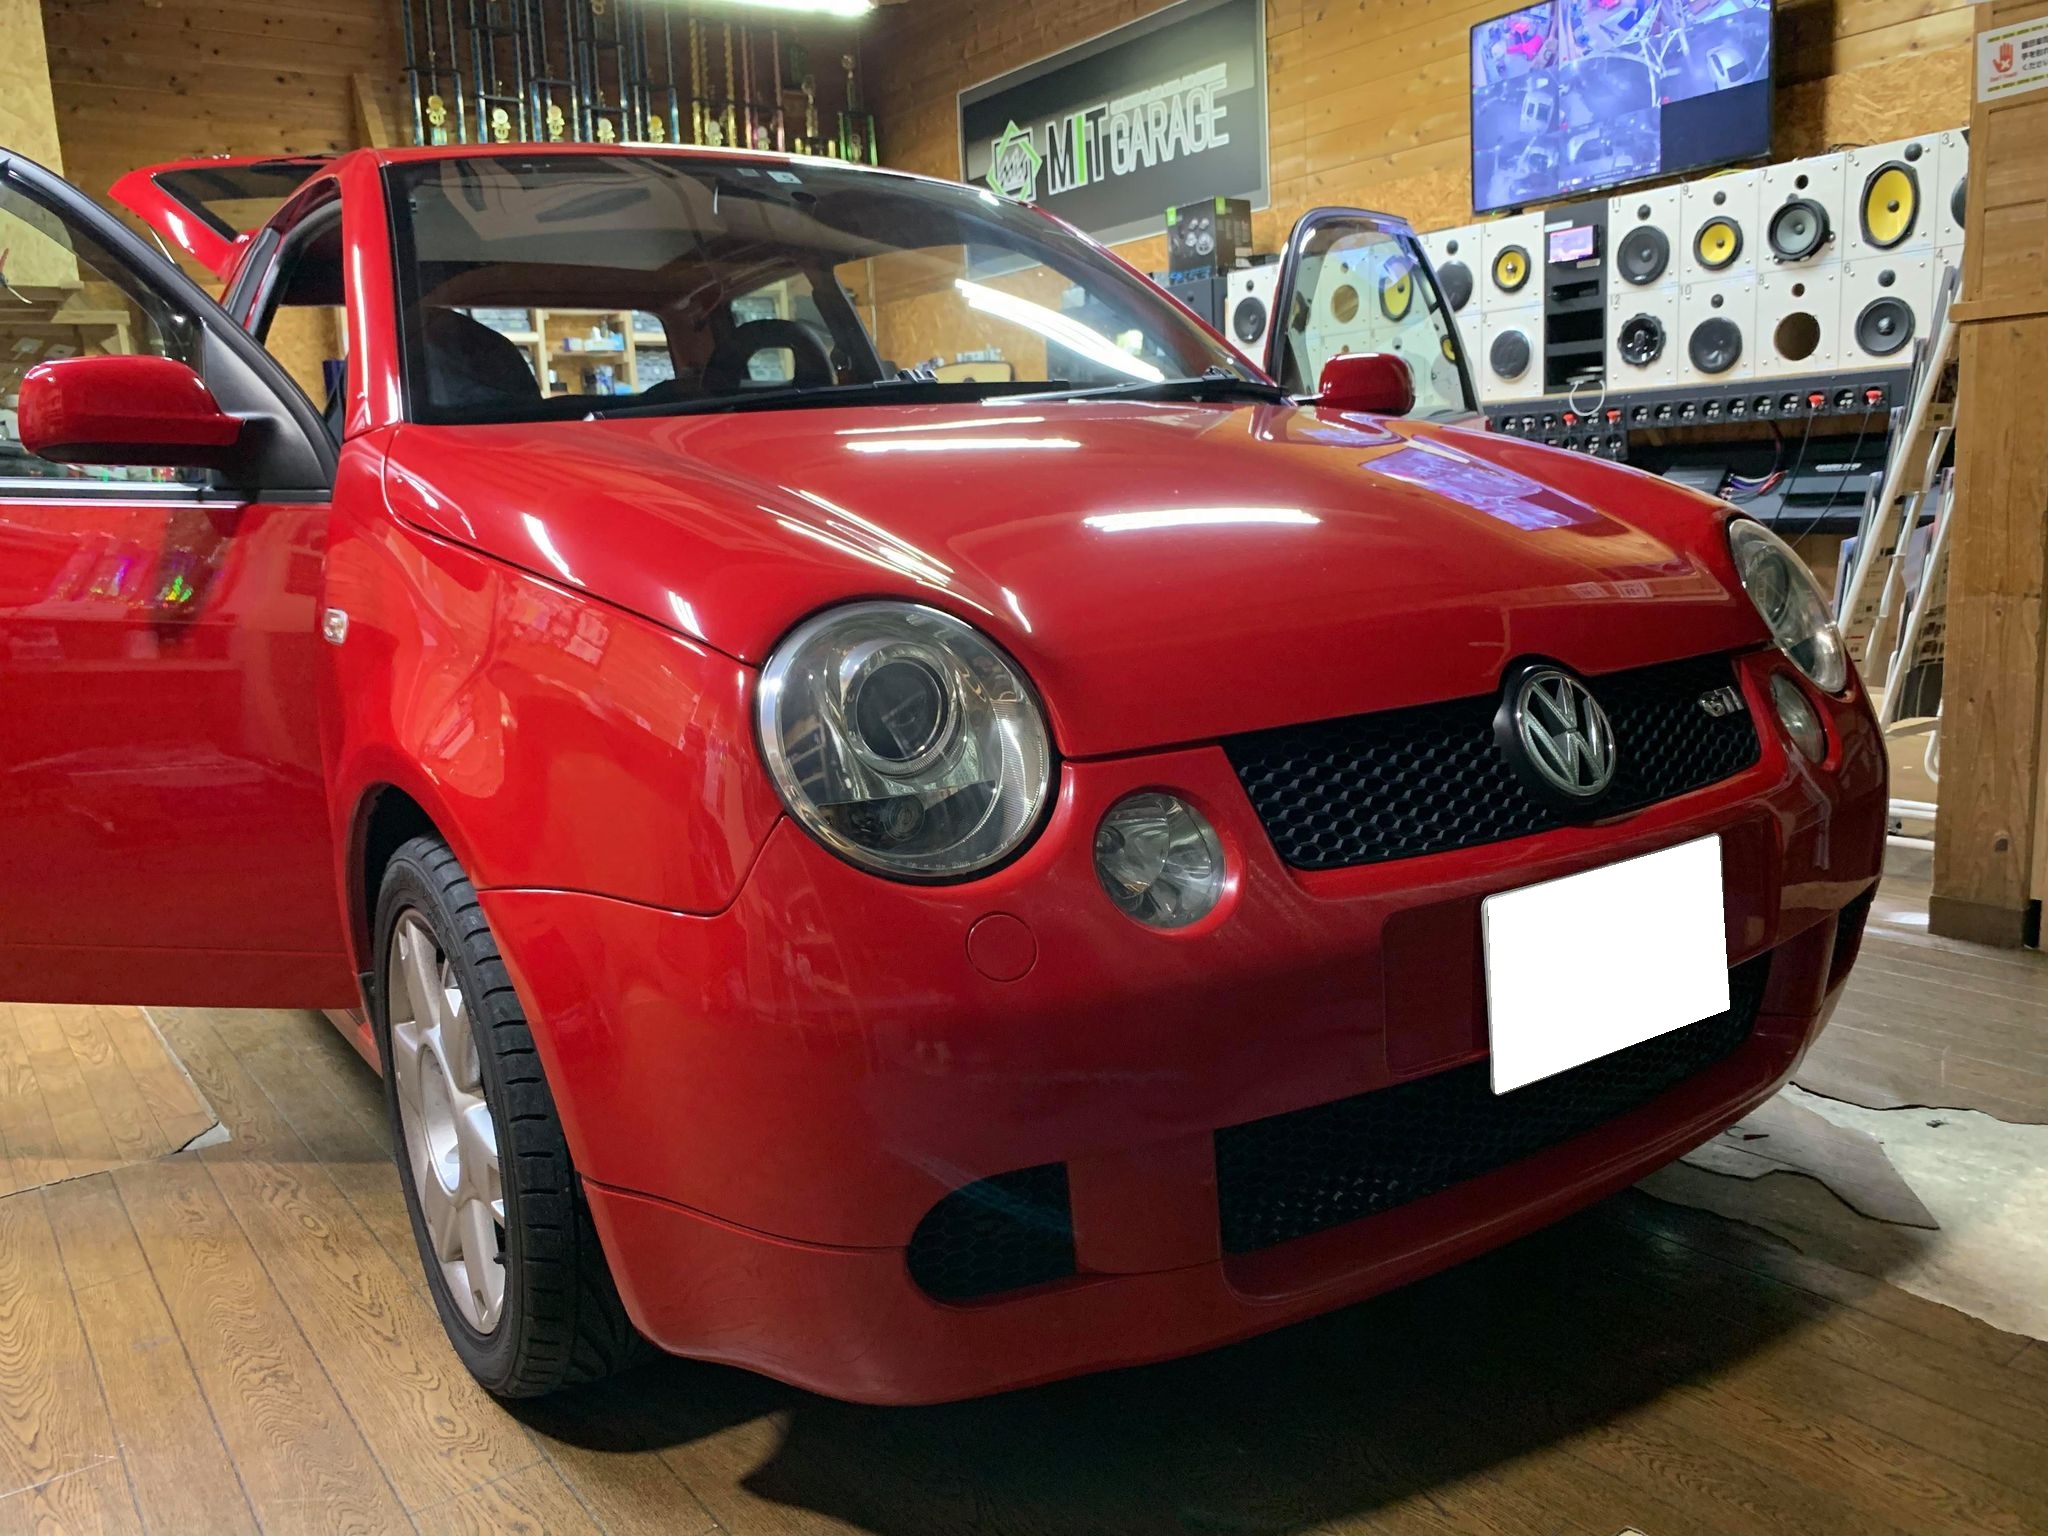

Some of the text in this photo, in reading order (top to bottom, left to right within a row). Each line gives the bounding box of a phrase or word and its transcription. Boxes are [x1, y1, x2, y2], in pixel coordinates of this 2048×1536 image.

[1046, 103, 1108, 195] MIT
[1110, 77, 1229, 176] GARAGE
[1942, 132, 1950, 145] 3
[1847, 151, 1855, 163] 5
[1761, 169, 1768, 181] 7
[1682, 184, 1689, 196] 9
[1936, 248, 1943, 260] 4
[1843, 262, 1851, 274] 6
[1680, 284, 1692, 296] 10
[1610, 294, 1621, 306] 12
